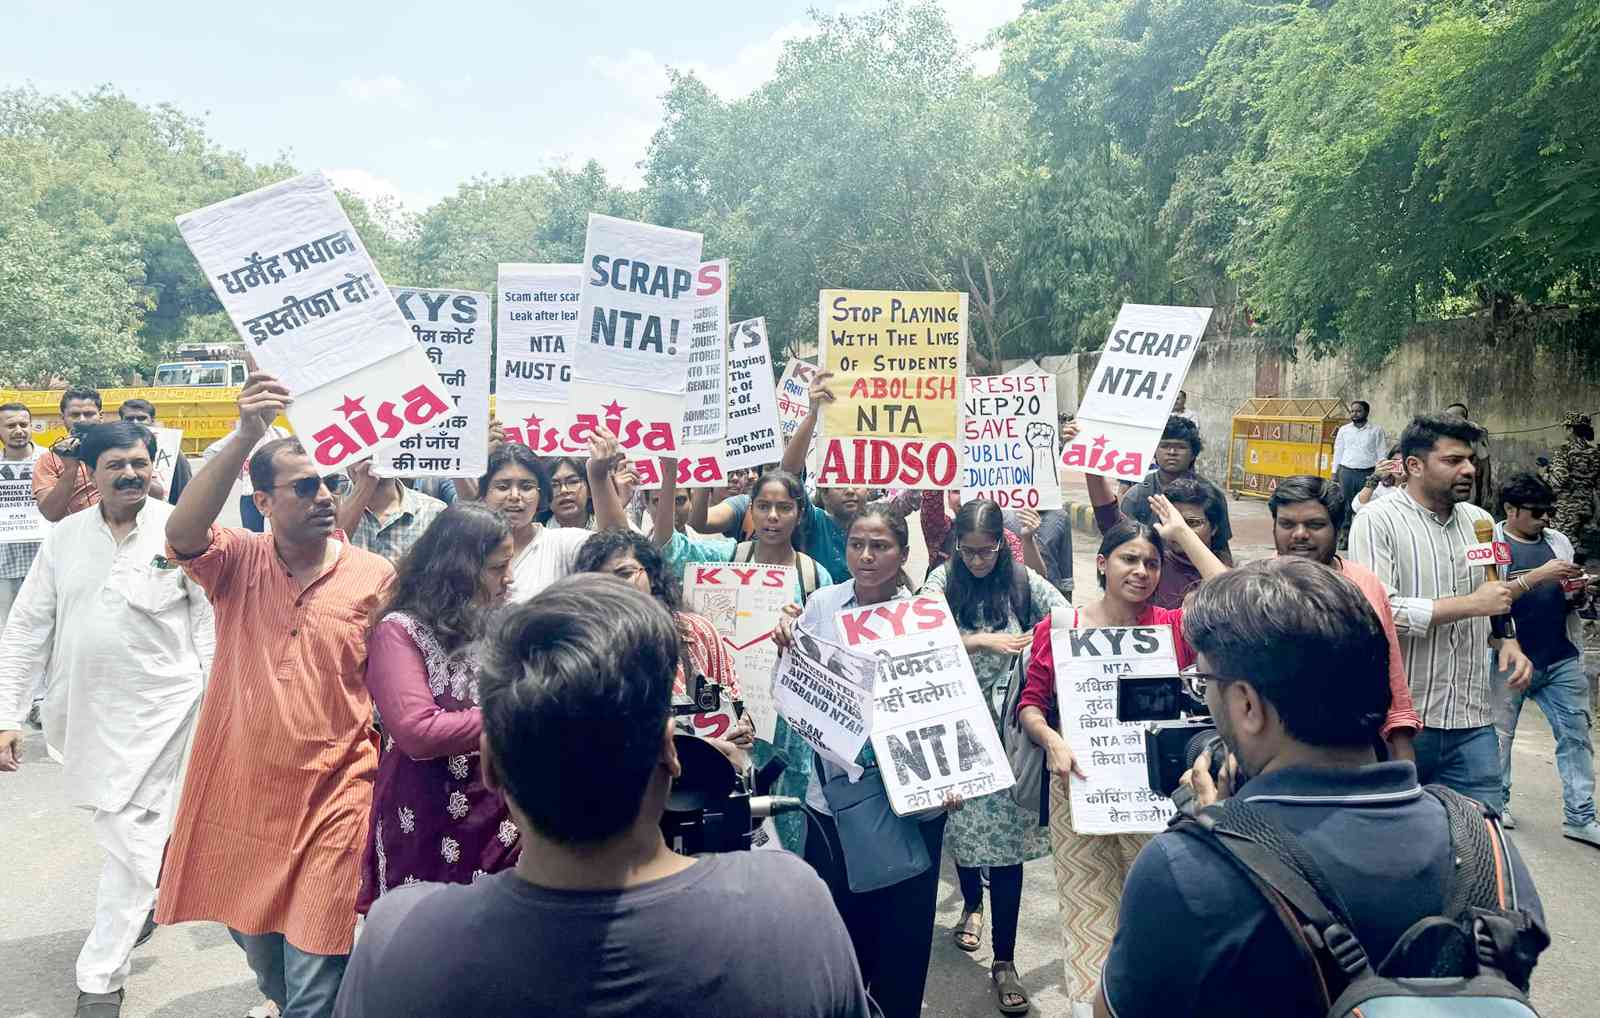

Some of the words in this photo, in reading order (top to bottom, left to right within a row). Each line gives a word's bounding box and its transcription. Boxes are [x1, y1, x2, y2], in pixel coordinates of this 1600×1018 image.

[217, 251, 287, 294] धर्मेंद्र
[283, 230, 356, 273] प्रधान
[590, 254, 692, 299] SCRAP
[505, 292, 531, 302] Scam
[533, 291, 557, 302] after
[242, 295, 340, 346] इस्तीफा
[336, 273, 380, 303] दो!
[510, 311, 533, 321] Leak
[535, 311, 559, 321] after
[832, 297, 882, 322] STOP
[891, 299, 959, 323] PLAYING
[440, 327, 475, 344] कोर्ट
[590, 306, 680, 356] NTA!
[831, 330, 878, 346] WITH
[886, 329, 917, 346] THE
[927, 328, 959, 346] LIVES
[530, 335, 566, 353] NTA
[1110, 329, 1192, 358] SCRAP
[505, 360, 556, 381] MUST
[729, 354, 766, 370] laying
[840, 356, 858, 371] OF
[873, 355, 958, 371] STUDENTS
[729, 371, 751, 382] The
[740, 380, 752, 392] Of
[970, 376, 1049, 393] RESIST
[1098, 366, 1172, 400] NTA!
[850, 376, 957, 400] ABOLISH
[738, 393, 751, 405] Of
[729, 404, 760, 419] rants!
[857, 405, 922, 433] NTA
[312, 384, 449, 466] aisa
[965, 418, 1019, 440] SAVE
[425, 431, 460, 450] जाँच
[726, 434, 748, 448] rupt
[750, 428, 774, 442] NTA
[743, 440, 775, 454] Down!
[392, 453, 414, 471] की
[817, 439, 958, 486] AIDSO
[1062, 434, 1143, 476] aisa
[696, 568, 785, 588] KYS
[841, 597, 946, 646] KYS
[1069, 628, 1160, 657] KYS
[1104, 662, 1133, 674] NTA
[780, 674, 829, 713] DISBAND
[1090, 735, 1121, 748] NTA
[886, 718, 994, 786] NTA
